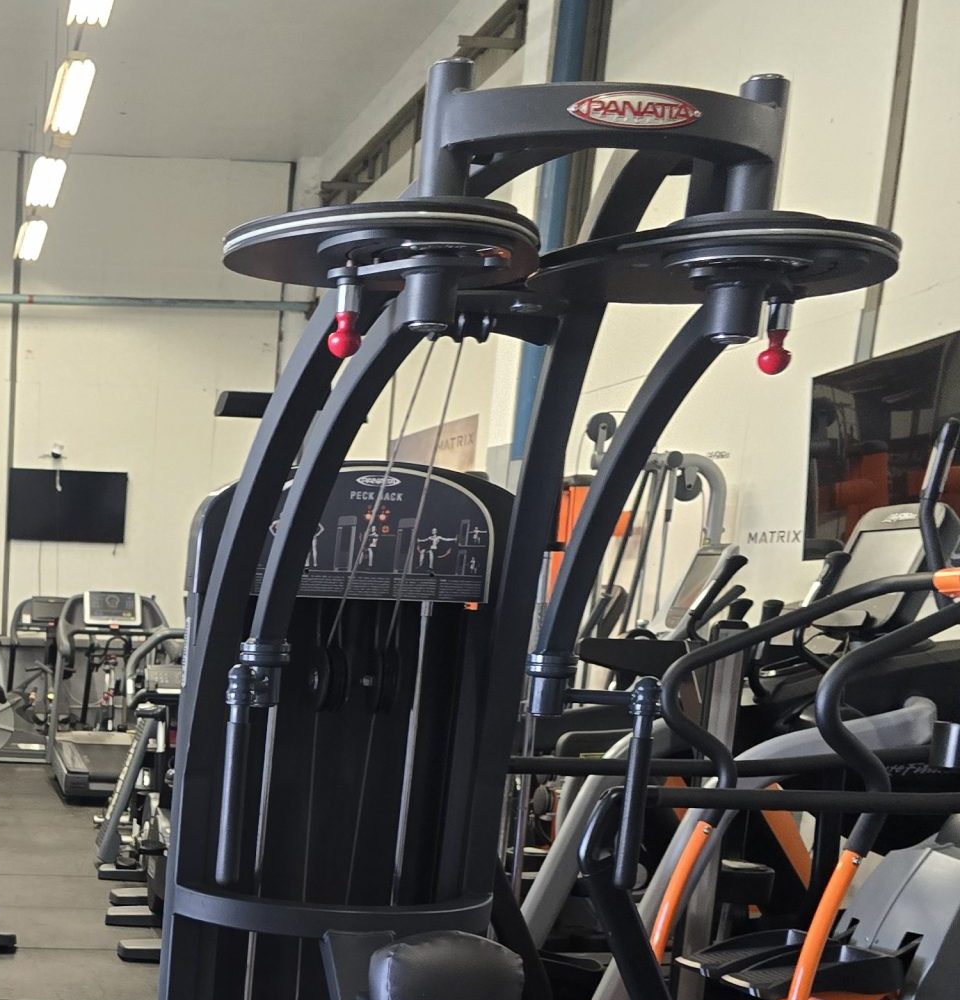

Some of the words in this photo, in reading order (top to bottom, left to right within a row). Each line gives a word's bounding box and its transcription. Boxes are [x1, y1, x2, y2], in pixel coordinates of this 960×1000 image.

[586, 99, 690, 119] PANATTA
[350, 491, 375, 500] PECK
[380, 492, 403, 501] ACK
[747, 530, 801, 544] MATRIX
